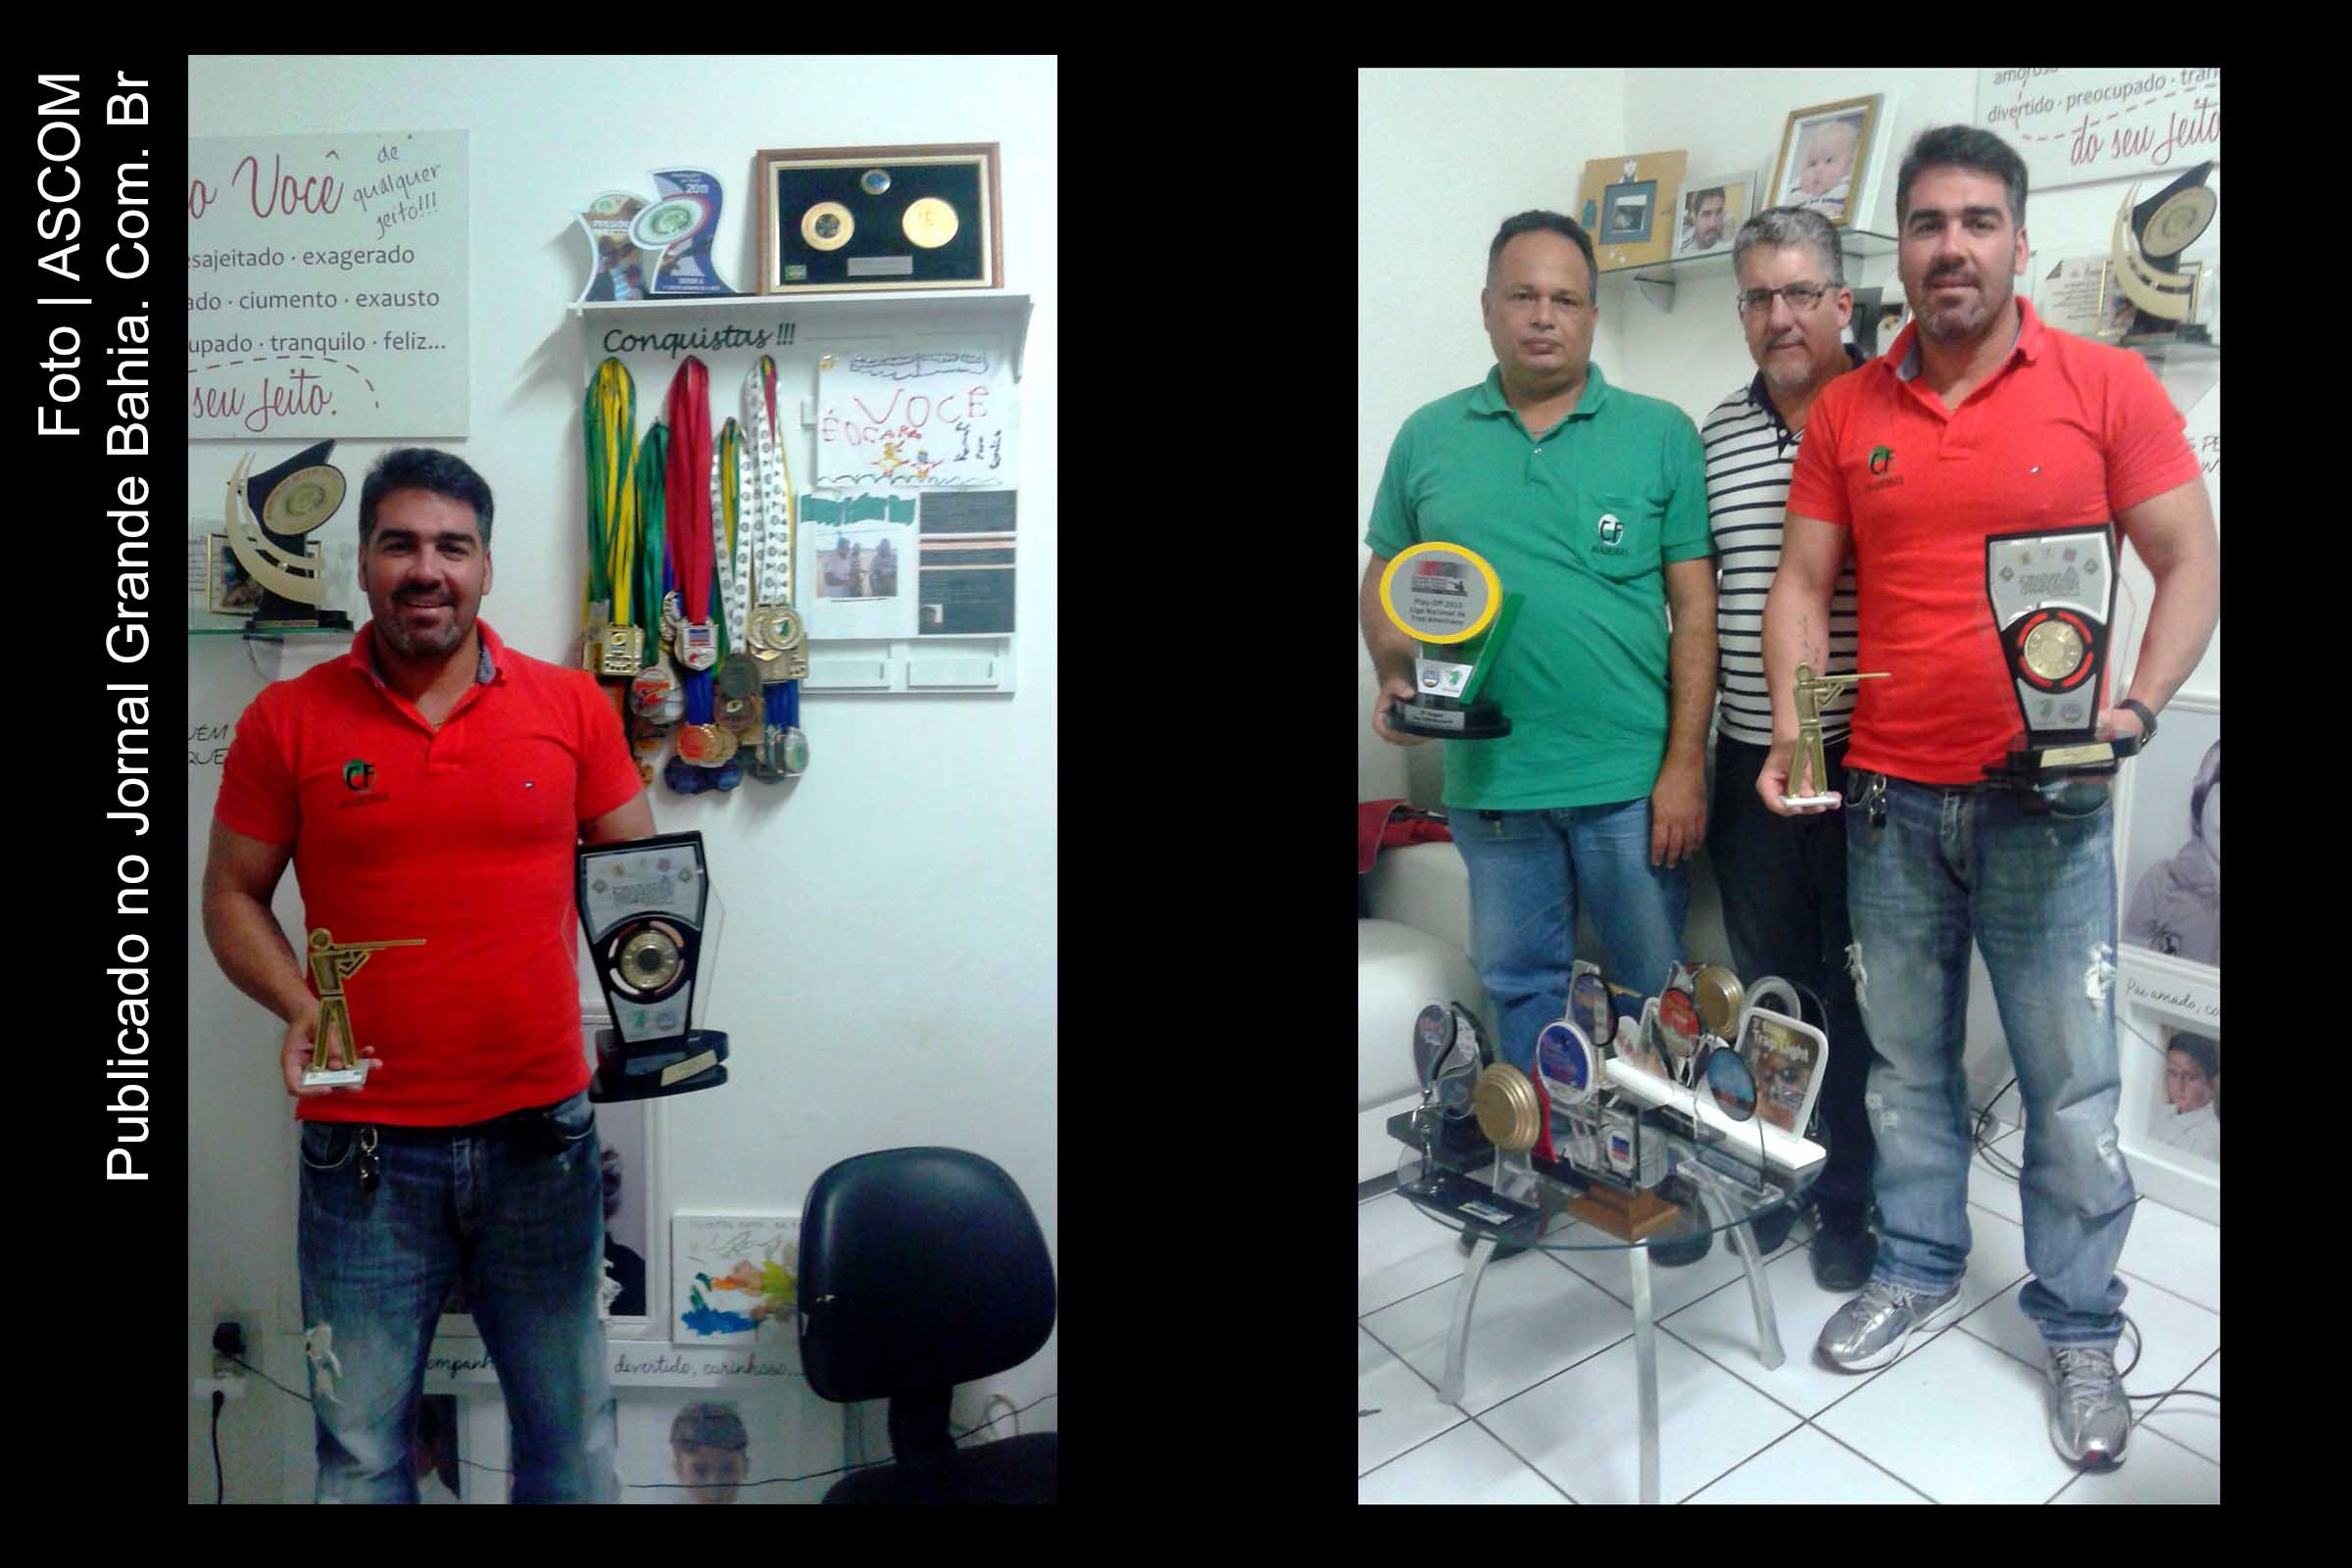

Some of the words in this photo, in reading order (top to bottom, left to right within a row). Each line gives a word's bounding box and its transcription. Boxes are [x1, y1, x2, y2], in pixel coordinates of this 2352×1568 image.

[1987, 95, 2054, 122] divertido
[2065, 73, 2166, 114] preocupado
[376, 144, 399, 164] de
[2070, 114, 2105, 167] do
[2111, 124, 2155, 159] seu
[231, 149, 345, 219] Você
[353, 164, 441, 213] qualquer
[302, 244, 416, 270] exagerado
[239, 291, 338, 310] ciumento
[356, 290, 440, 309] exausto
[270, 331, 367, 356] tranquilo
[383, 332, 446, 351] feliz...
[604, 324, 773, 359] Conquistas
[193, 386, 245, 418] seu
